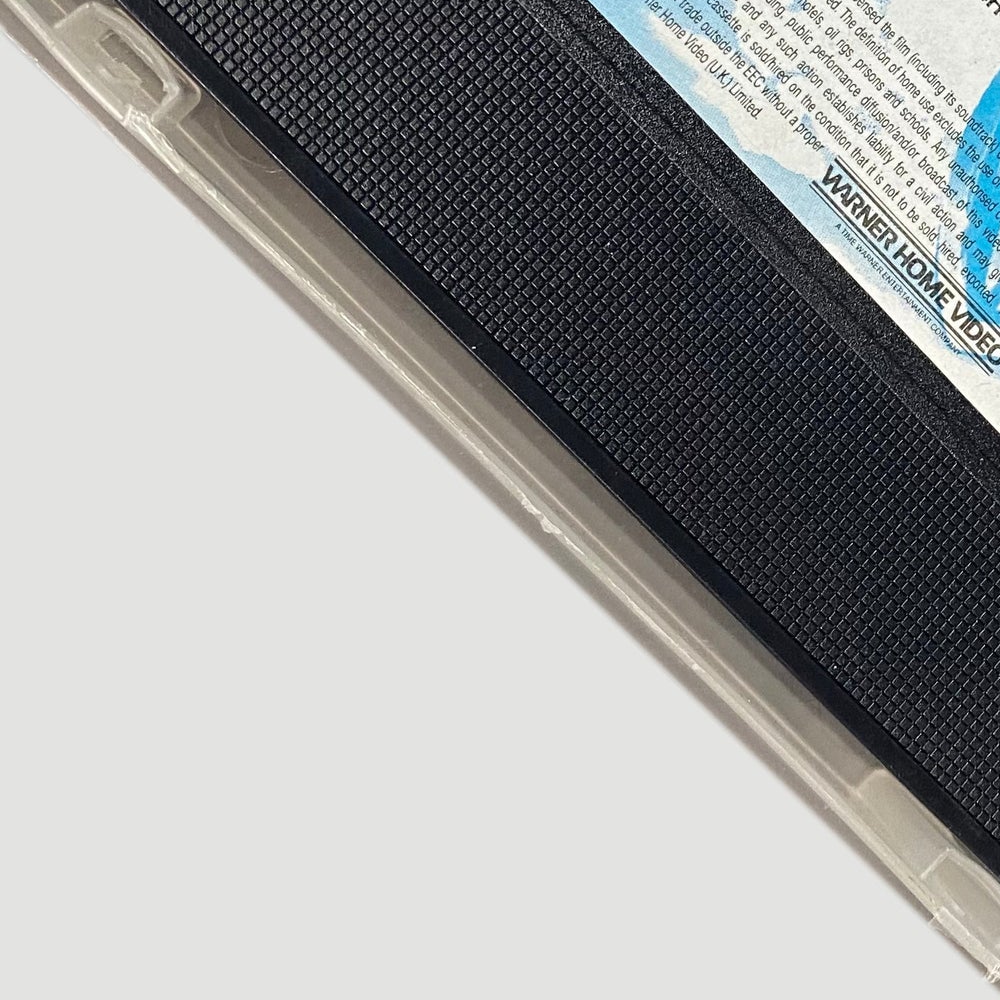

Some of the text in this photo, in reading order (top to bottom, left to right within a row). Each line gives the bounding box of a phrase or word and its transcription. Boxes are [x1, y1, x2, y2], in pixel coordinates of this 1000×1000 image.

[658, 7, 686, 39] Home
[683, 33, 709, 63] Video
[699, 21, 732, 55] outside
[742, 64, 765, 88] EEC
[760, 83, 794, 119] without
[792, 122, 825, 151] proper
[839, 6, 857, 29] The
[853, 26, 891, 66] definition
[896, 69, 920, 98] home
[932, 111, 967, 149] excludes
[892, 35, 910, 57] film
[740, 0, 763, 20] and
[758, 19, 777, 39] any
[775, 37, 798, 61] such
[795, 60, 823, 89] action
[822, 87, 870, 135] establishes
[864, 129, 894, 165] liability
[914, 185, 935, 205] civil
[930, 203, 957, 232] action
[955, 230, 976, 249] and
[971, 247, 992, 271] may
[783, 16, 813, 45] public
[808, 44, 861, 97] performance
[917, 155, 958, 201] broadcast
[965, 208, 983, 228] this
[814, 110, 852, 151] condition
[849, 146, 870, 168] that
[851, 58, 885, 91] prisons
[882, 88, 904, 109] and
[930, 138, 950, 162] Any
[947, 157, 999, 212] unauthorised
[821, 163, 898, 251] WARNER
[892, 242, 955, 310] HOME
[840, 227, 963, 357] TIME WARNER ENTERTAINMENT COMPANY
